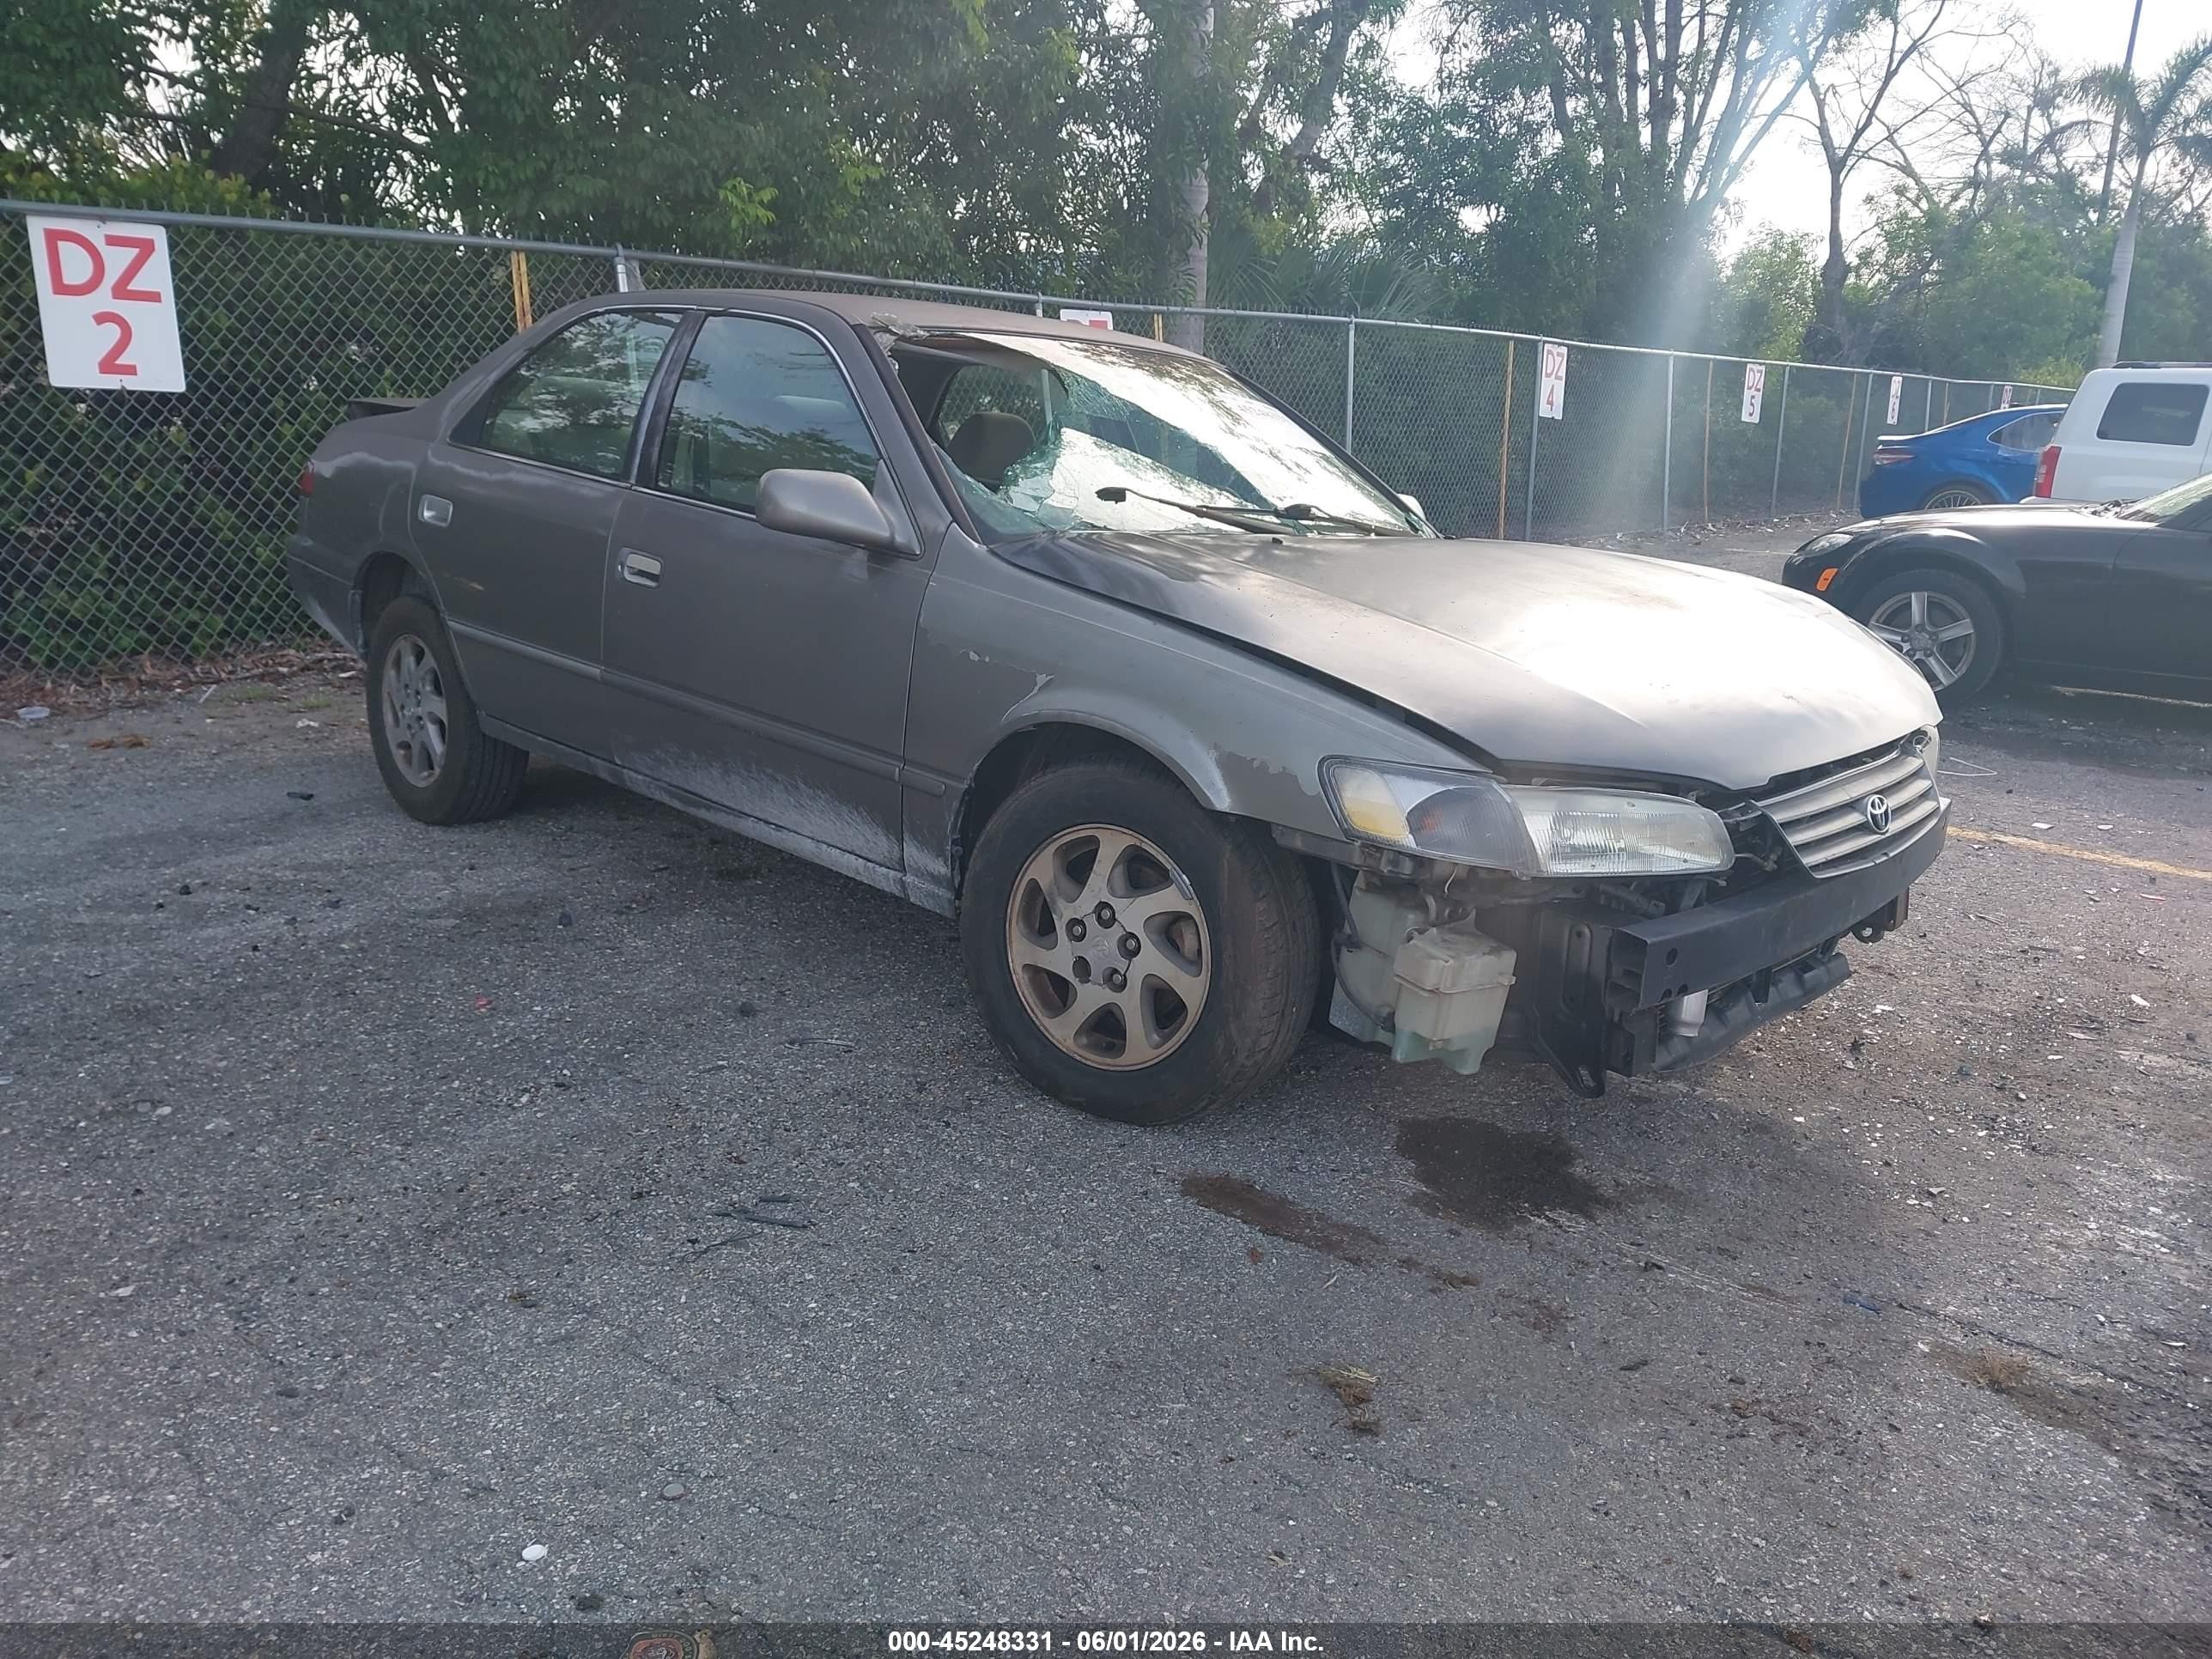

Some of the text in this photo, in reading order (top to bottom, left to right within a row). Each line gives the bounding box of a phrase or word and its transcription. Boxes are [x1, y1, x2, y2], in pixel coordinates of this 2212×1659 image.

[43, 228, 162, 303] DZ
[91, 311, 137, 376] 2
[1545, 349, 1565, 380] DZ
[1747, 367, 1763, 392] DZ
[1546, 384, 1554, 412] 4
[1748, 395, 1755, 416] 5
